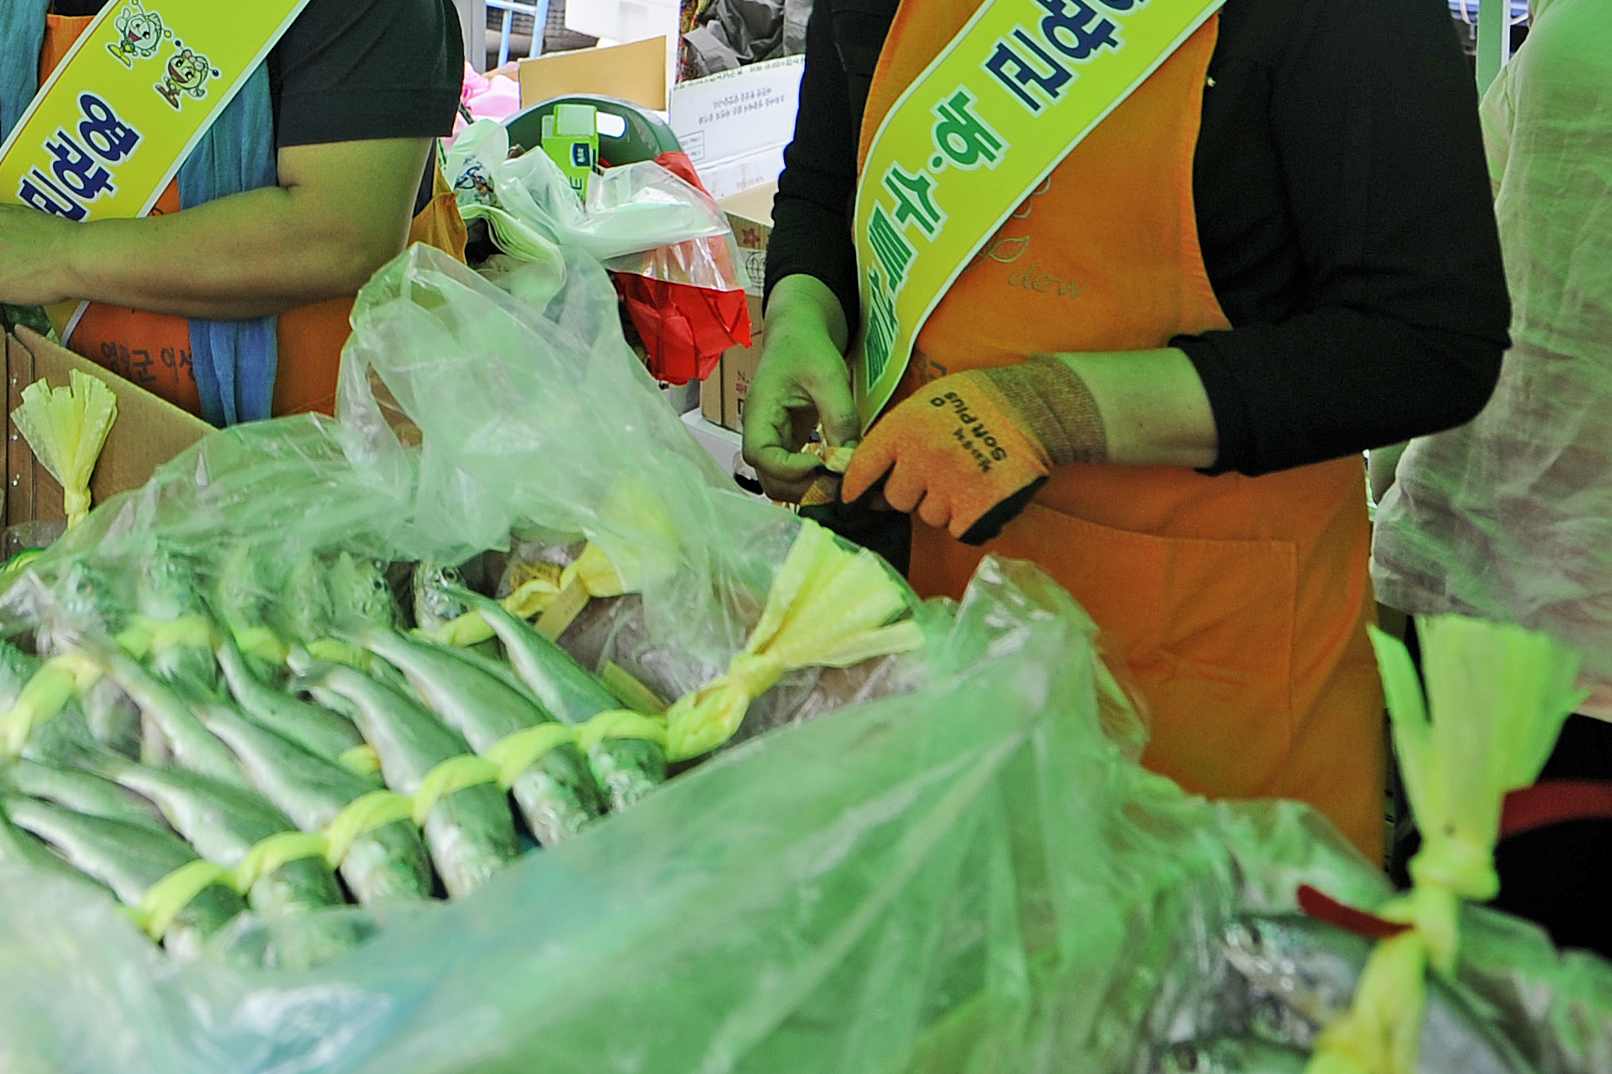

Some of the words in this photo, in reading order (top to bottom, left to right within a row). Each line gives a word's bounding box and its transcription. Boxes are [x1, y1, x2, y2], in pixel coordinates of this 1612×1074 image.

[19, 93, 140, 221] 영광군
[1008, 264, 1087, 299] dew
[943, 390, 980, 430] Plus
[966, 418, 1008, 462] Soft
